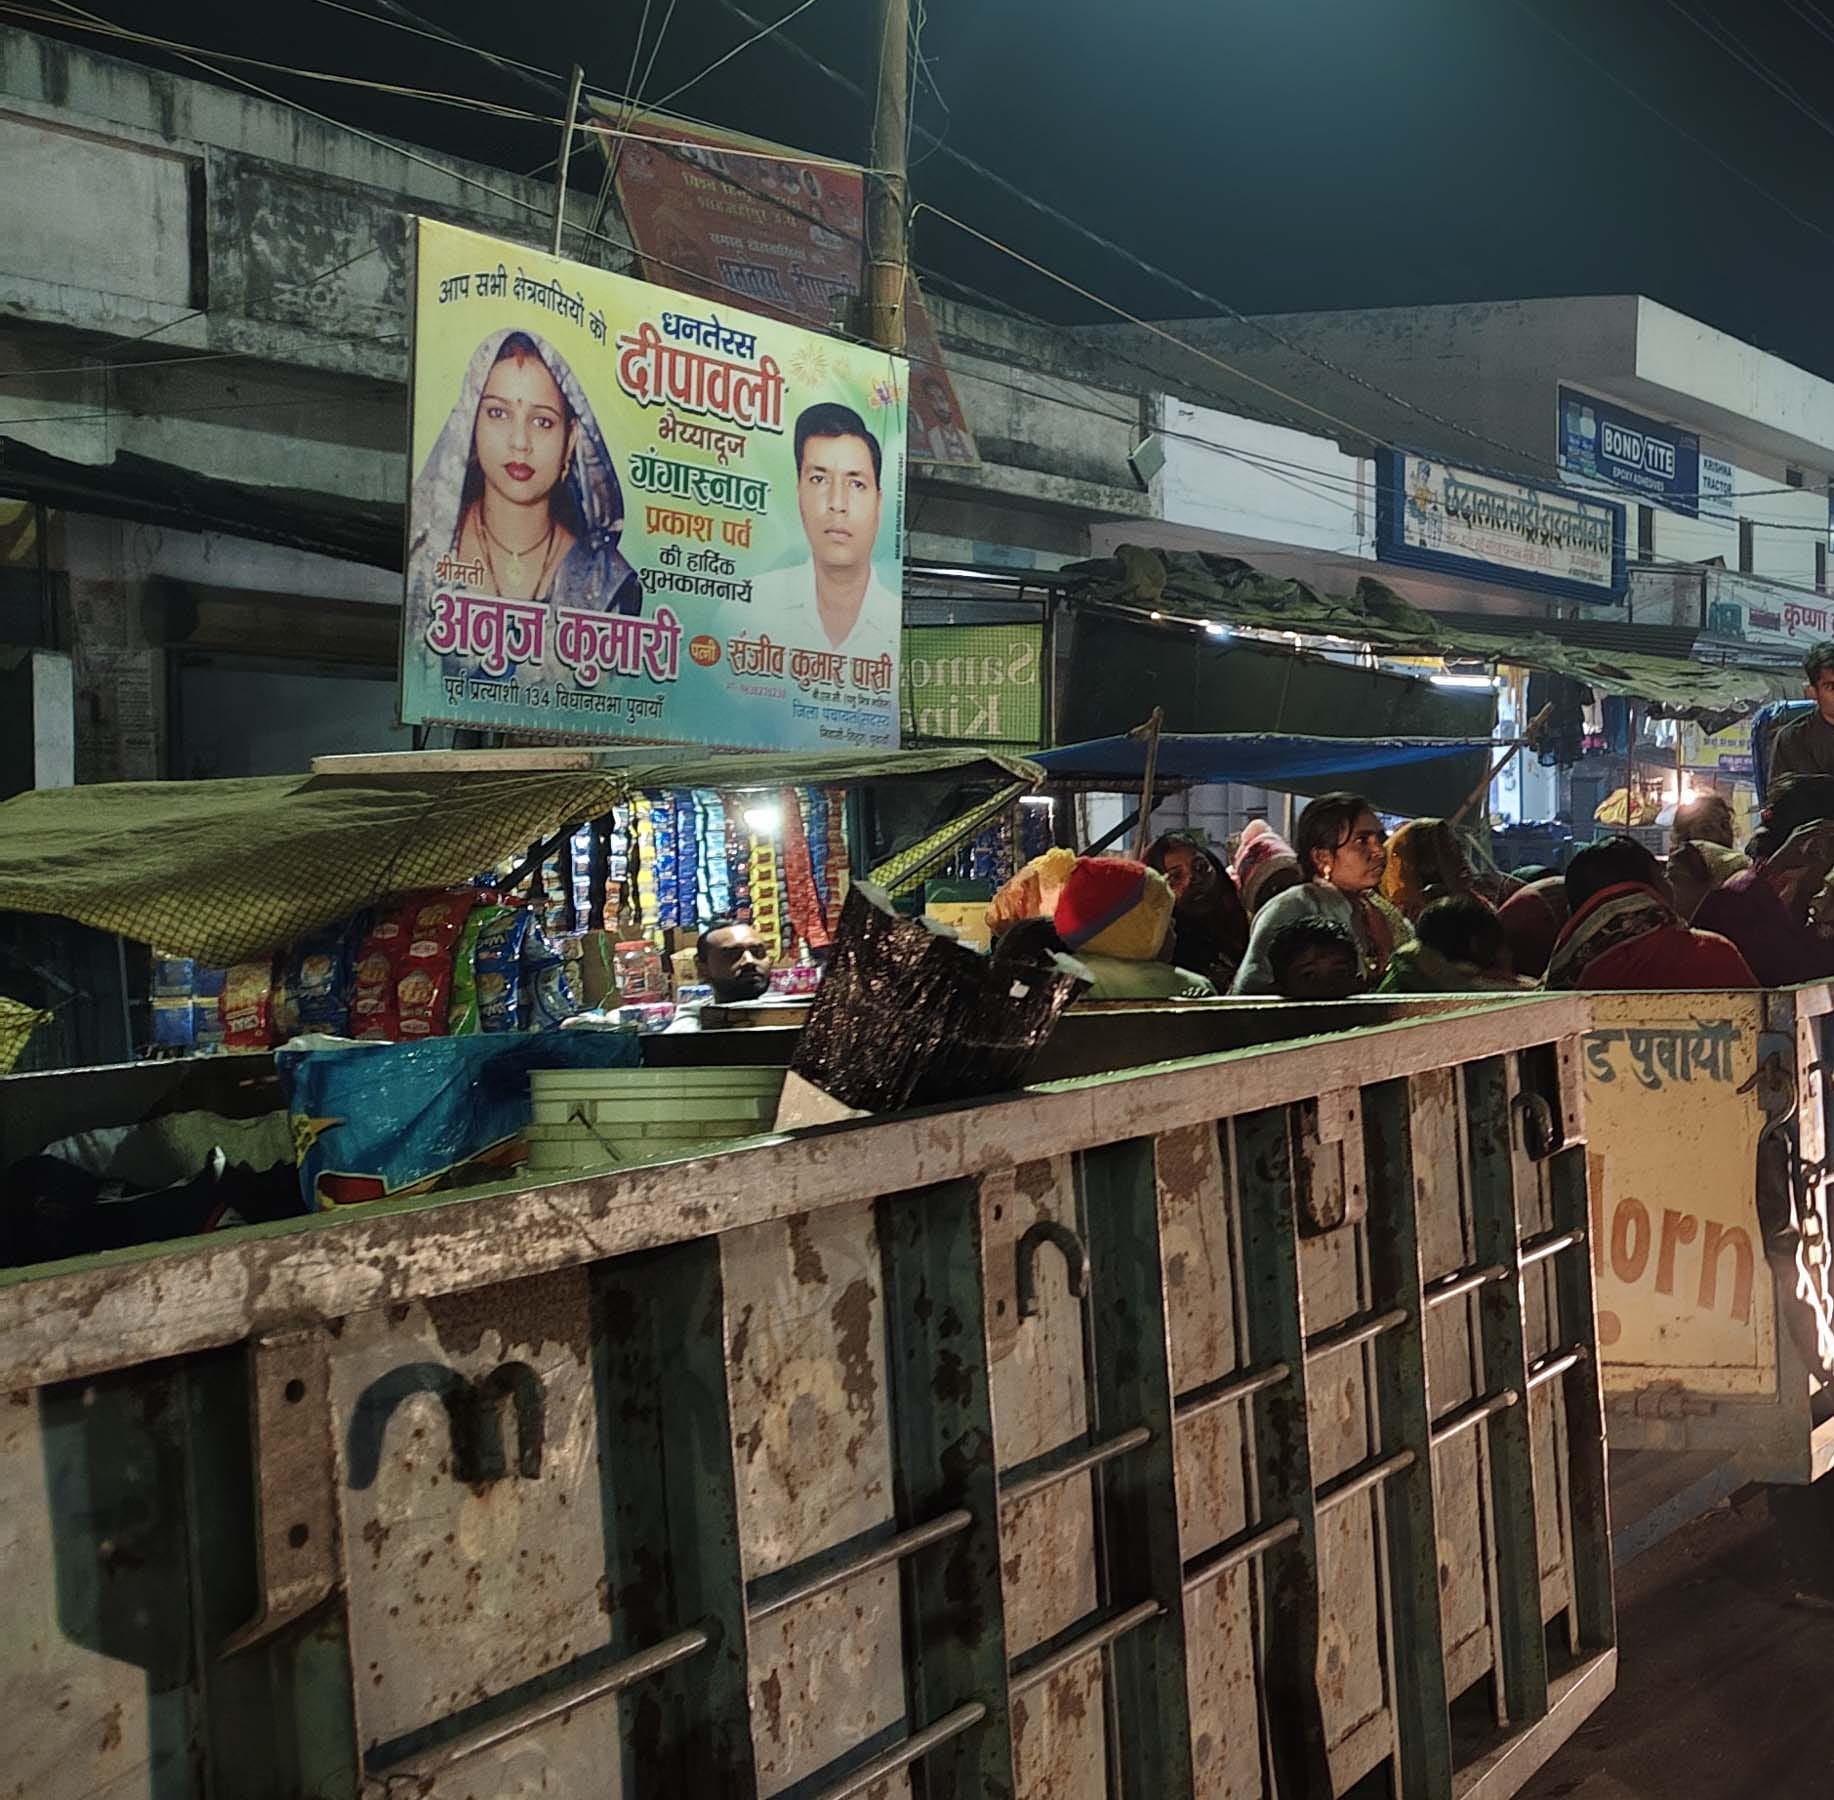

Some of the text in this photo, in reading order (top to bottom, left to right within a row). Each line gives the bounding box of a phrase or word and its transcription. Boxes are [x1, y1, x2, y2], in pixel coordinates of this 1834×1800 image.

[438, 264, 608, 346] आप सभी क्षेत्रवासियों को
[661, 311, 757, 360] धनतेरस
[617, 321, 786, 432] दीपावली
[1604, 428, 1641, 462] BOND
[1646, 442, 1674, 473] TITE
[630, 447, 769, 513] गंगास्नान
[1612, 466, 1665, 492] EPOXY ADHESIVES
[645, 506, 753, 549] प्रकाश पर्व
[435, 556, 484, 586] श्रीमती
[659, 544, 736, 576] की हार्दिक
[430, 590, 682, 683] अनुज कुमारी
[1783, 602, 1827, 637] कृष्णा
[727, 630, 893, 694] संजीव कुमार पासी
[444, 668, 466, 704] पूर्व
[526, 686, 550, 708] 134
[556, 685, 621, 714] विधानसभा
